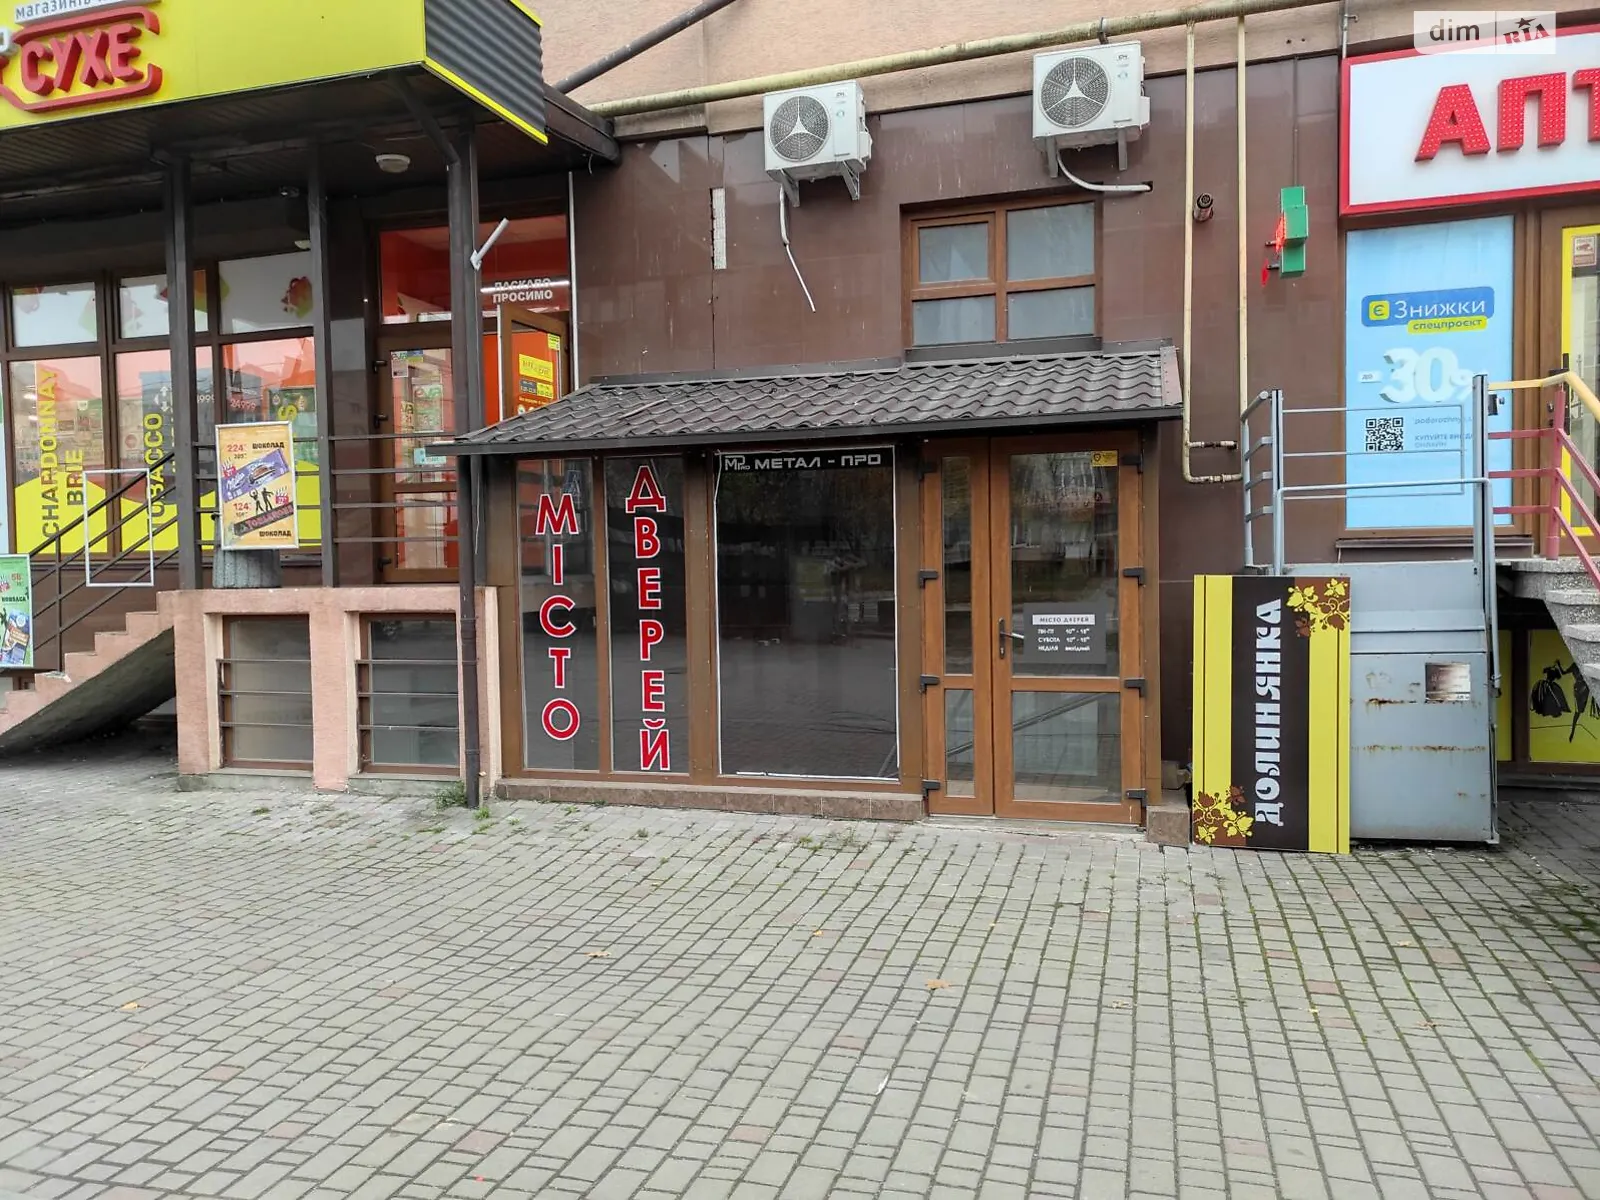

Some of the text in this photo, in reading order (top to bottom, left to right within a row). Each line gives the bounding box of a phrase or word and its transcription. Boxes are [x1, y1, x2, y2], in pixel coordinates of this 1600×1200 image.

[20, 23, 143, 96] СУХЕ
[492, 289, 553, 304] ПРОСИМО
[1394, 300, 1486, 319] Знижки
[1412, 319, 1483, 331] спецпроєкт
[40, 370, 60, 538] CHARDONNAY
[252, 441, 285, 449] ШОКОЛАД
[754, 456, 821, 470] МЕТАЛ
[840, 454, 882, 467] ПРО
[65, 448, 84, 506] BRIE
[535, 493, 580, 741] МІСТО
[625, 465, 671, 771] ДВЕРЕЙ
[1254, 598, 1285, 827] ДОЛИНЯНКА
